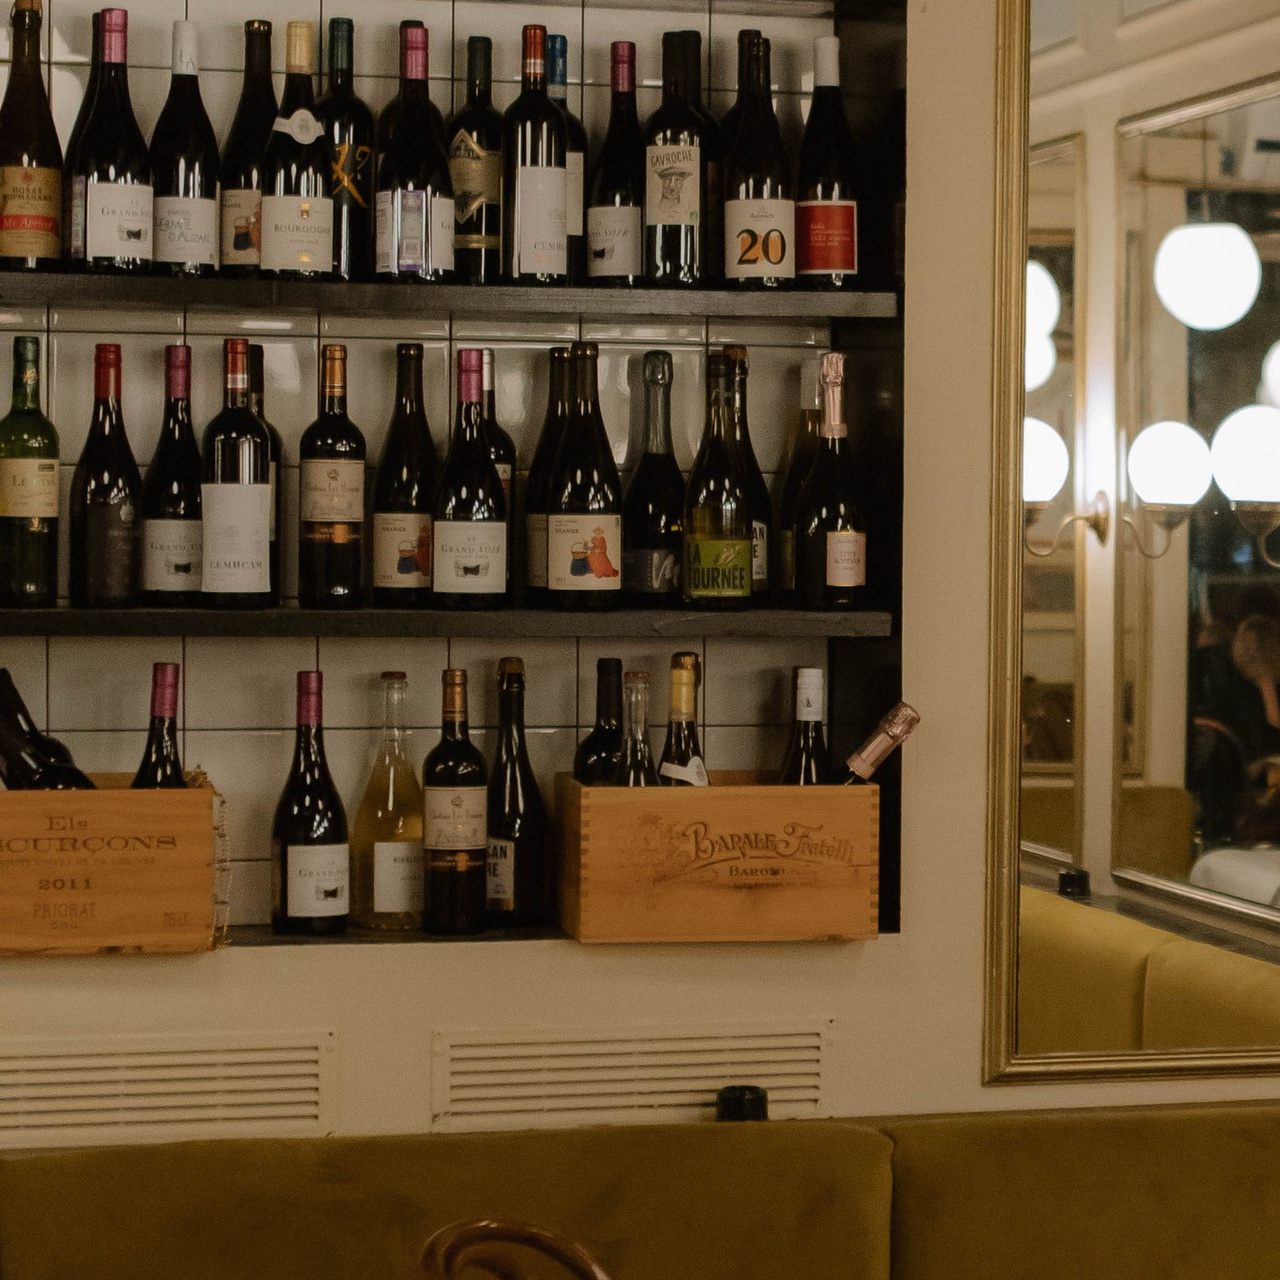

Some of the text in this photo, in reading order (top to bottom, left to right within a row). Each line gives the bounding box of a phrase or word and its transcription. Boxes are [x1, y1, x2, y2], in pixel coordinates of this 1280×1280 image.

[650, 149, 694, 168] GAVROCHE
[736, 228, 787, 266] 20
[46, 815, 88, 832] Els
[728, 865, 786, 878] BAROO
[38, 878, 93, 891] 2011
[32, 902, 97, 919] PRIORAT
